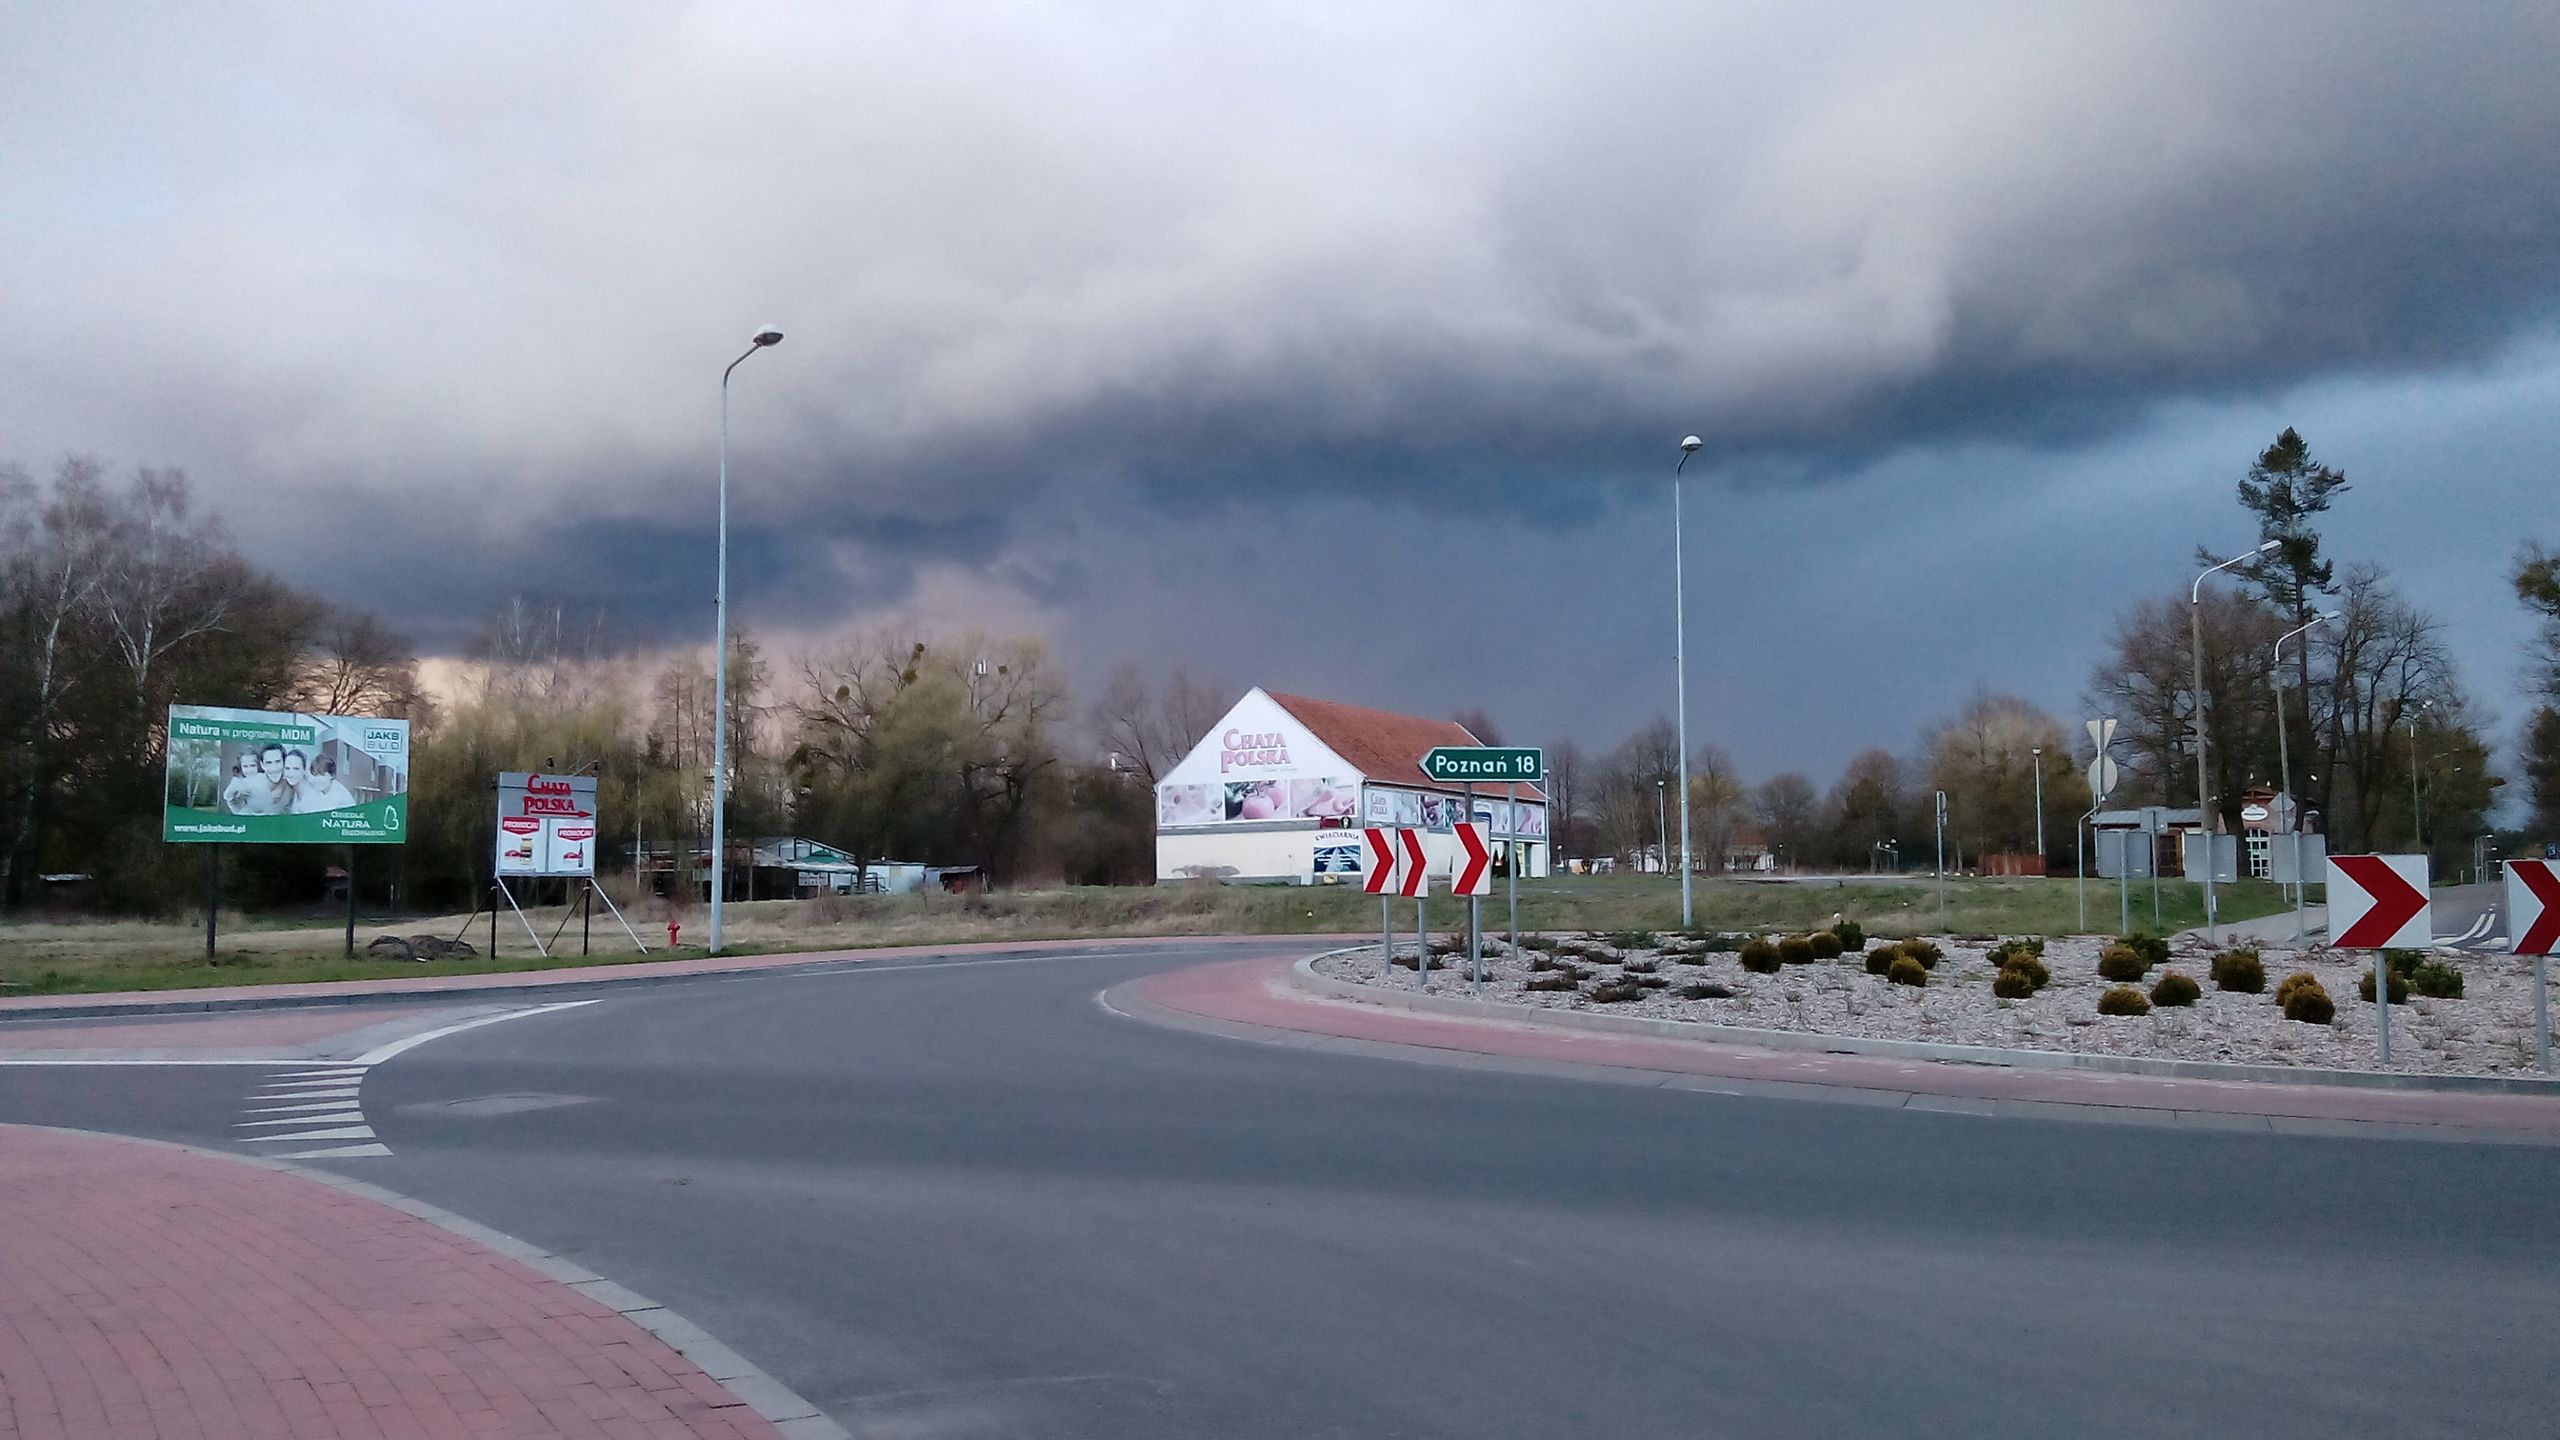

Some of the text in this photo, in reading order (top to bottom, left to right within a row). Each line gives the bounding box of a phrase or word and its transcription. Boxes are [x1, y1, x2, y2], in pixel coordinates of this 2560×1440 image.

[179, 723, 220, 736] Natura
[232, 729, 279, 739] programie
[281, 729, 310, 740] MDM
[367, 731, 399, 740] JAKS
[1223, 728, 1287, 751] CHATA
[367, 741, 399, 750] BUD
[1220, 749, 1292, 774] POLSKA
[1436, 755, 1535, 773] Poznań 18
[523, 796, 575, 816] POLSKA
[322, 818, 371, 829] NATURA
